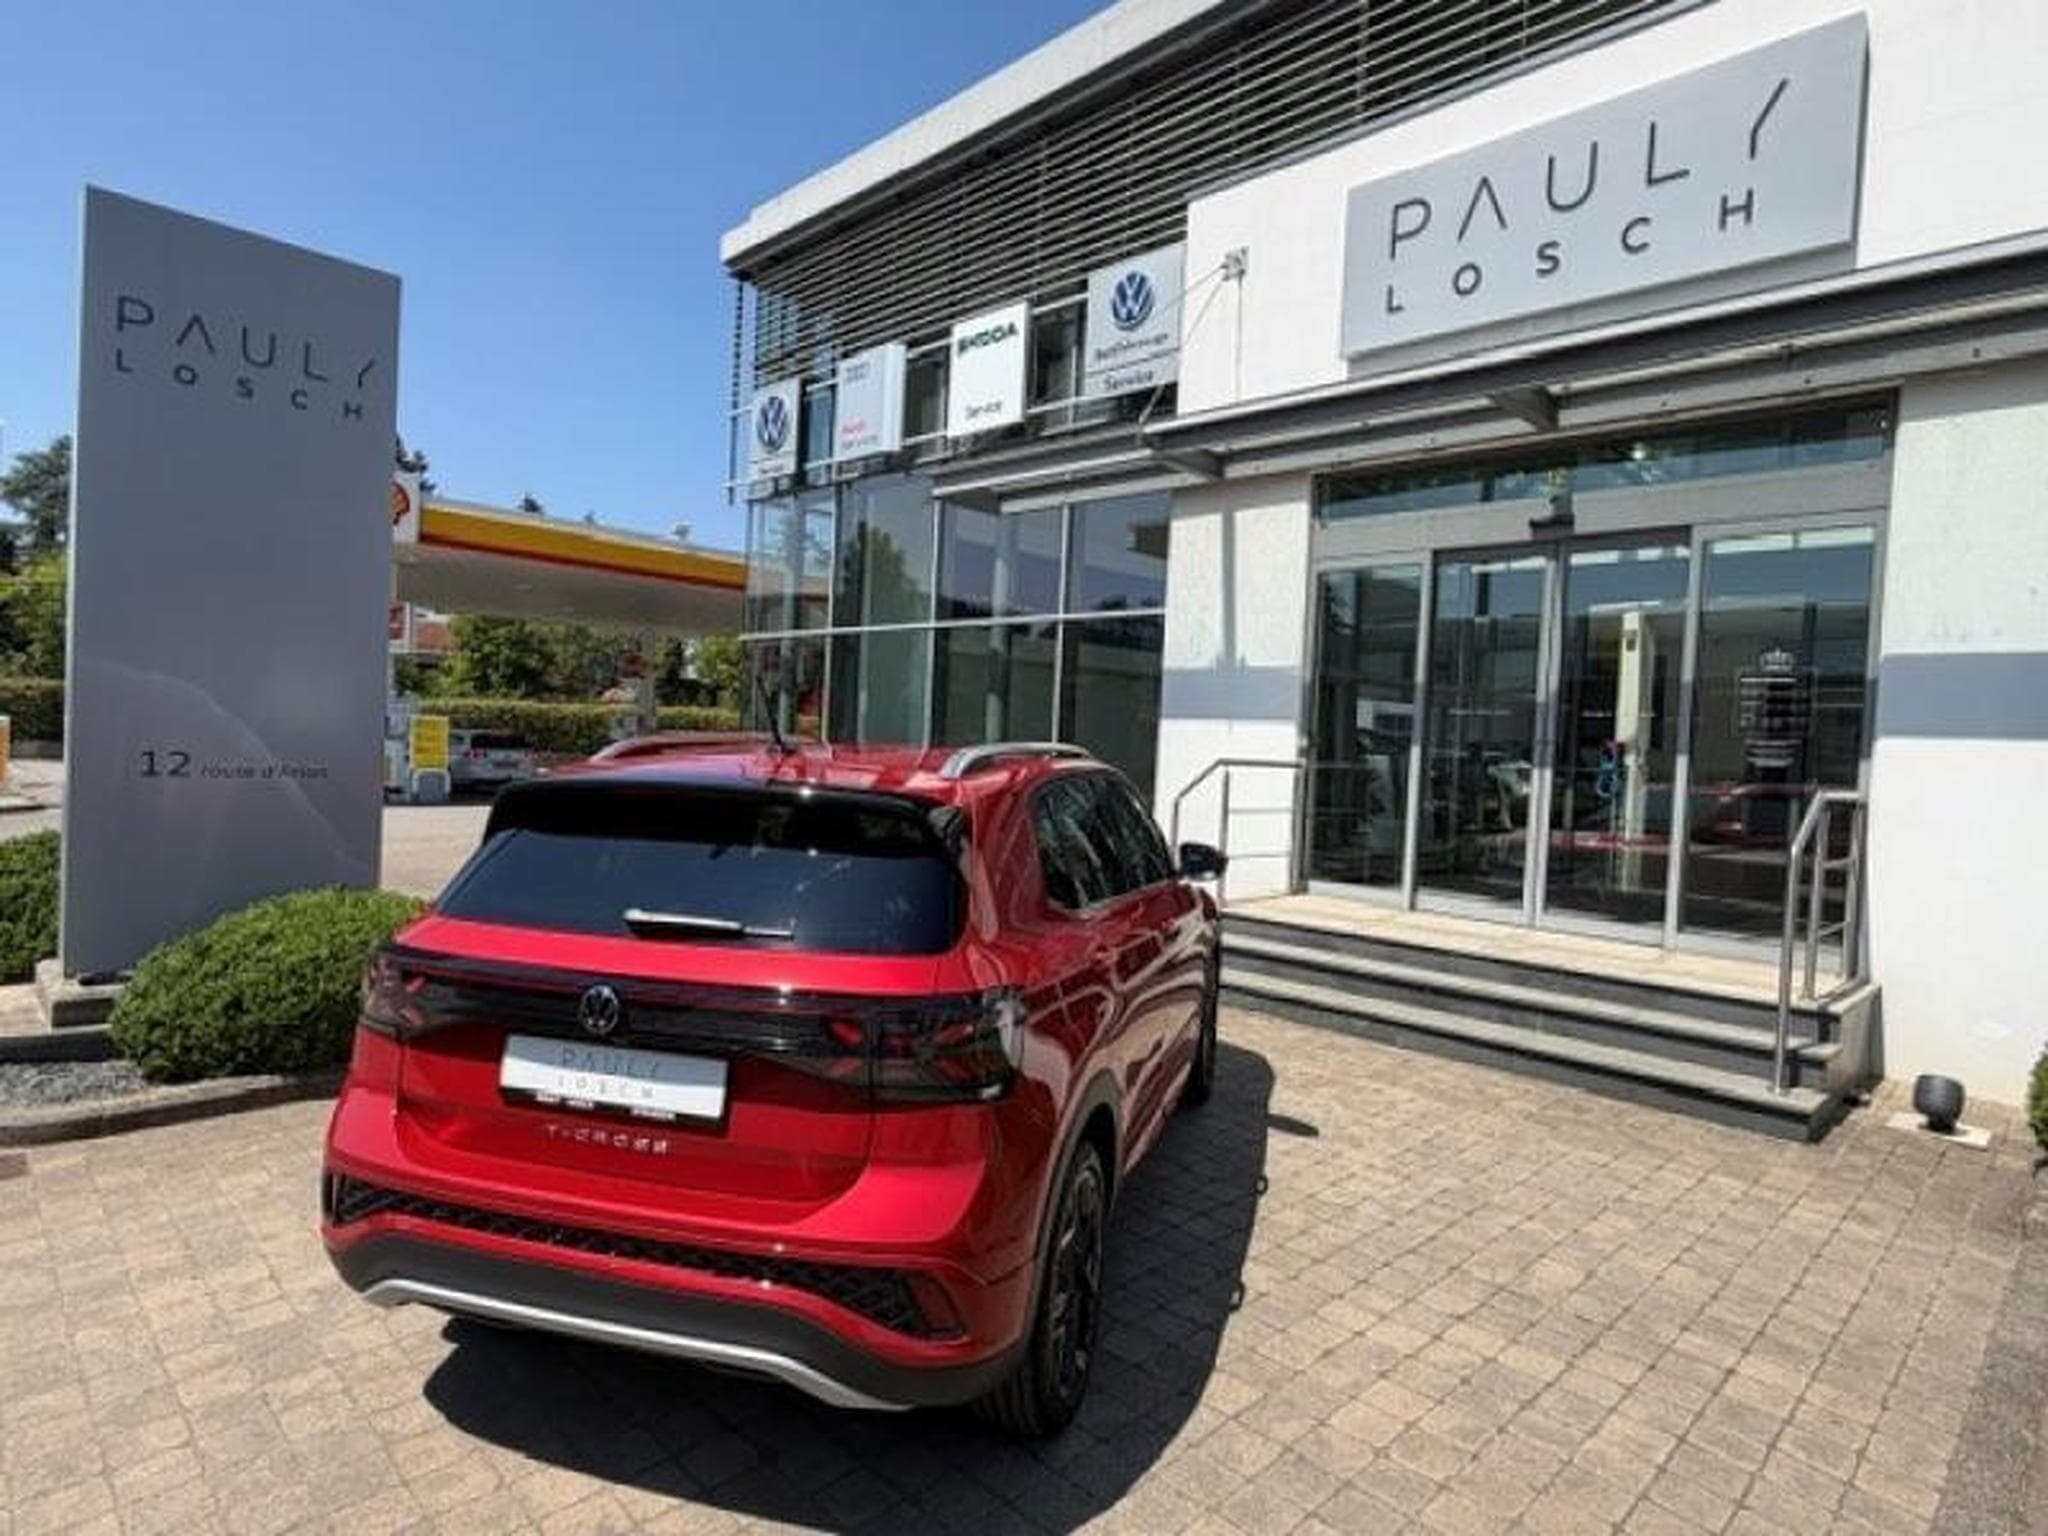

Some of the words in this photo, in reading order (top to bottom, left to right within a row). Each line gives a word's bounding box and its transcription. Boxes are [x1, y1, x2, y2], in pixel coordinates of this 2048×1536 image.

[1390, 77, 1789, 261] PAULY
[1385, 187, 1754, 314] LOSCH
[114, 347, 363, 421] LOSCH
[116, 295, 376, 390] PAULY
[140, 750, 192, 778] 12
